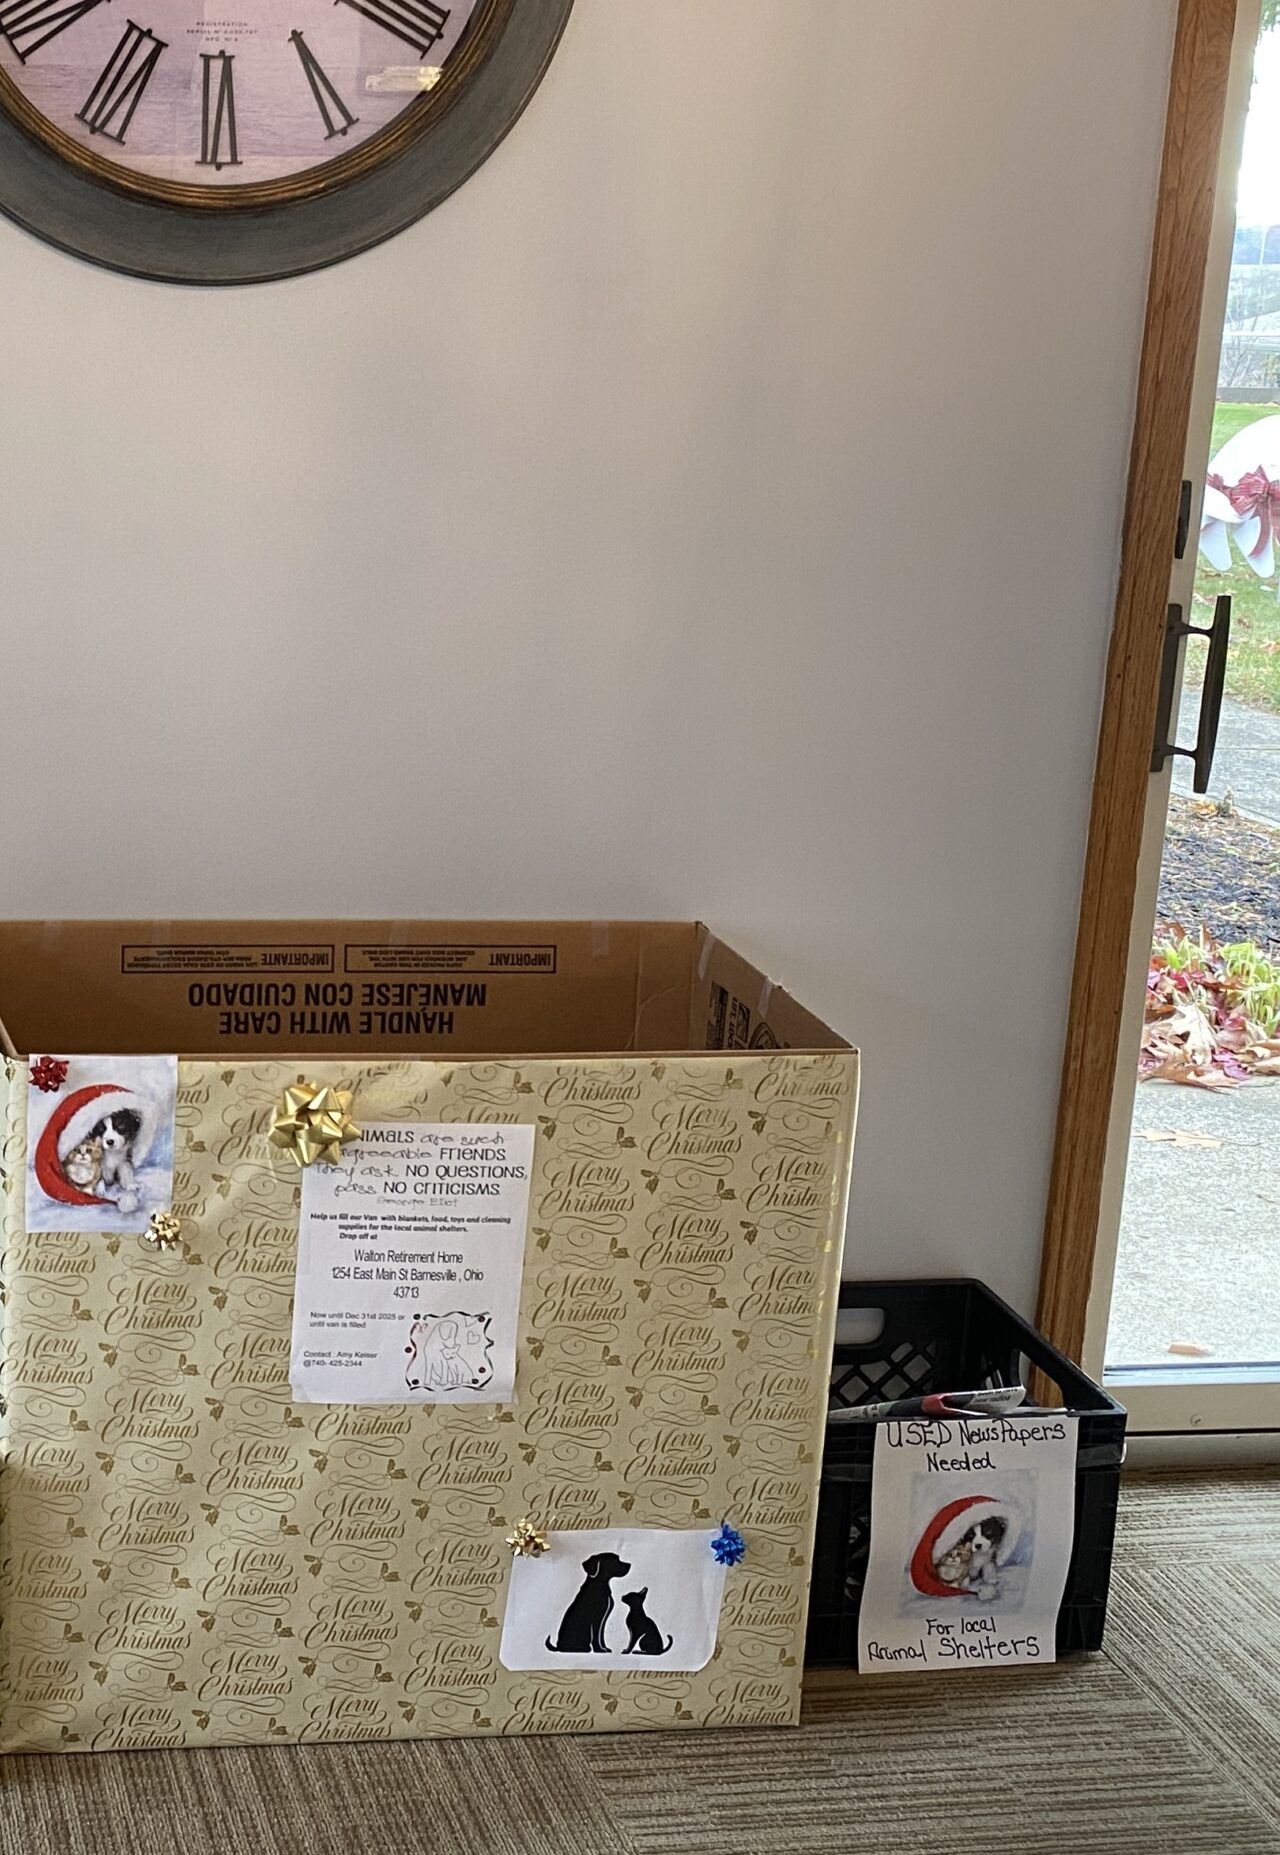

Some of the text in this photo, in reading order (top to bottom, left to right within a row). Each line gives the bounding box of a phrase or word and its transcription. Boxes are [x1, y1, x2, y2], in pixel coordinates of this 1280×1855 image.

[261, 953, 329, 966] IMPORTANTE
[488, 953, 551, 966] IMPORTANT
[188, 983, 294, 1006] CUIDADO
[305, 983, 353, 1006] CON
[219, 1012, 453, 1034] HANDLE WITH CARE
[544, 1077, 640, 1107] Christmas
[406, 1165, 429, 1177] NO
[384, 1182, 407, 1194] NO
[311, 1213, 327, 1221] Help
[451, 1216, 465, 1224] toys
[481, 1216, 511, 1224] cleaning
[338, 1224, 367, 1232] supplies
[394, 1224, 411, 1232] local
[653, 1213, 729, 1245] Merry
[339, 1233, 358, 1241] Drop
[359, 1232, 369, 1240] off
[354, 1249, 463, 1263] Walton Retirement Home
[640, 1242, 735, 1271] Christmas
[332, 1267, 351, 1279] 1254
[354, 1267, 373, 1280] East
[376, 1268, 396, 1280] Main
[398, 1268, 408, 1280] St
[411, 1269, 456, 1281] Barnesville
[464, 1270, 484, 1280] Ohio
[393, 1287, 419, 1298] 43713
[531, 1299, 628, 1329] Christmas
[337, 1351, 353, 1359] Amy
[885, 1423, 952, 1448] USED
[624, 1455, 717, 1483] Christmas
[927, 1452, 996, 1472] Needed
[110, 1496, 189, 1527] Merry
[322, 1492, 400, 1523] Merry
[2, 1548, 81, 1582] Merry
[423, 1539, 500, 1569] Merry
[410, 1566, 505, 1593] Christmas
[724, 1579, 798, 1609] Merry
[925, 1617, 996, 1635] For local
[95, 1629, 191, 1654] Christmas
[867, 1636, 1040, 1663] Animal Shelters
[210, 1649, 287, 1682] Merry
[198, 1675, 293, 1702] Christmas
[514, 1685, 589, 1714] Merry
[715, 1679, 789, 1710] Merry
[103, 1704, 181, 1733] Merry
[310, 1694, 387, 1726] Merry
[298, 1720, 391, 1740] Christmas
